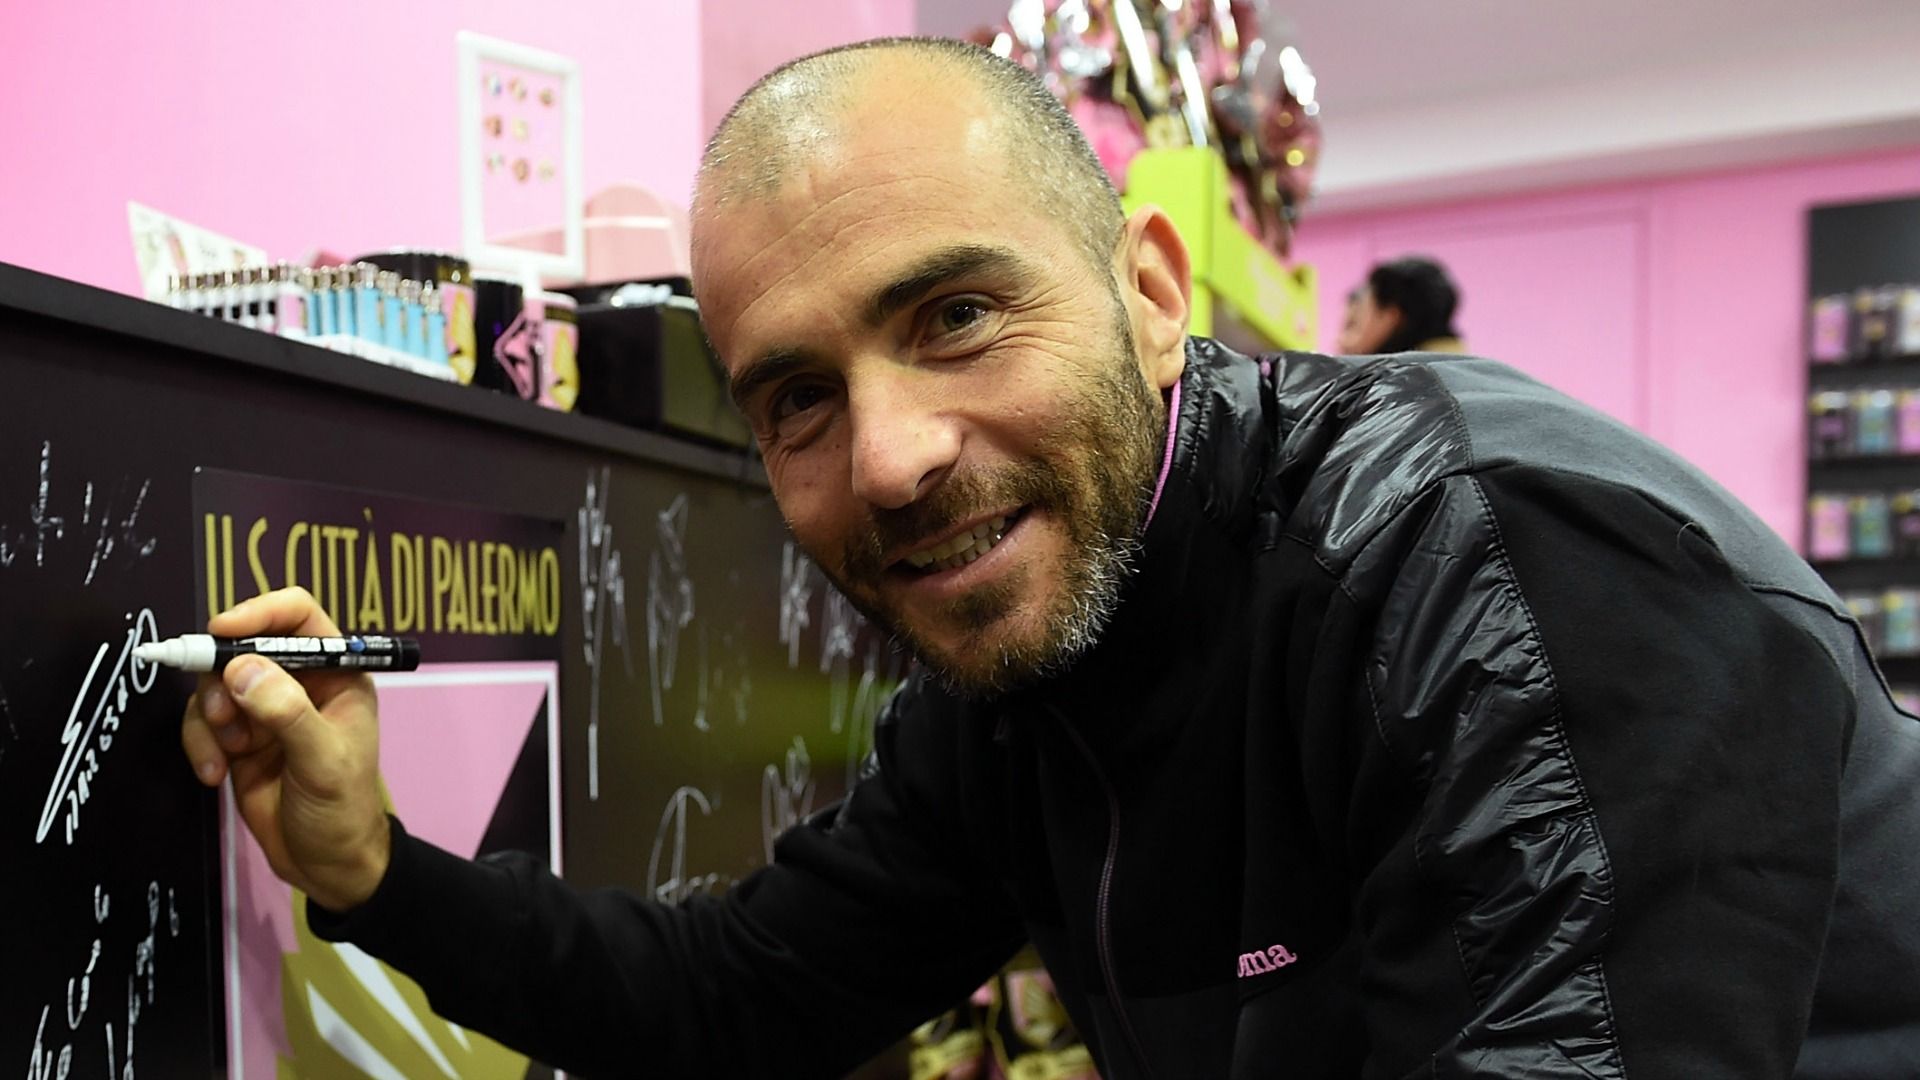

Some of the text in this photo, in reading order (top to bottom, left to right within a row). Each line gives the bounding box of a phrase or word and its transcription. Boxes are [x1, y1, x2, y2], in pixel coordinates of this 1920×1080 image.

[285, 506, 386, 632] CITTÀ
[391, 532, 426, 632] DI
[431, 535, 560, 635] PALERMO
